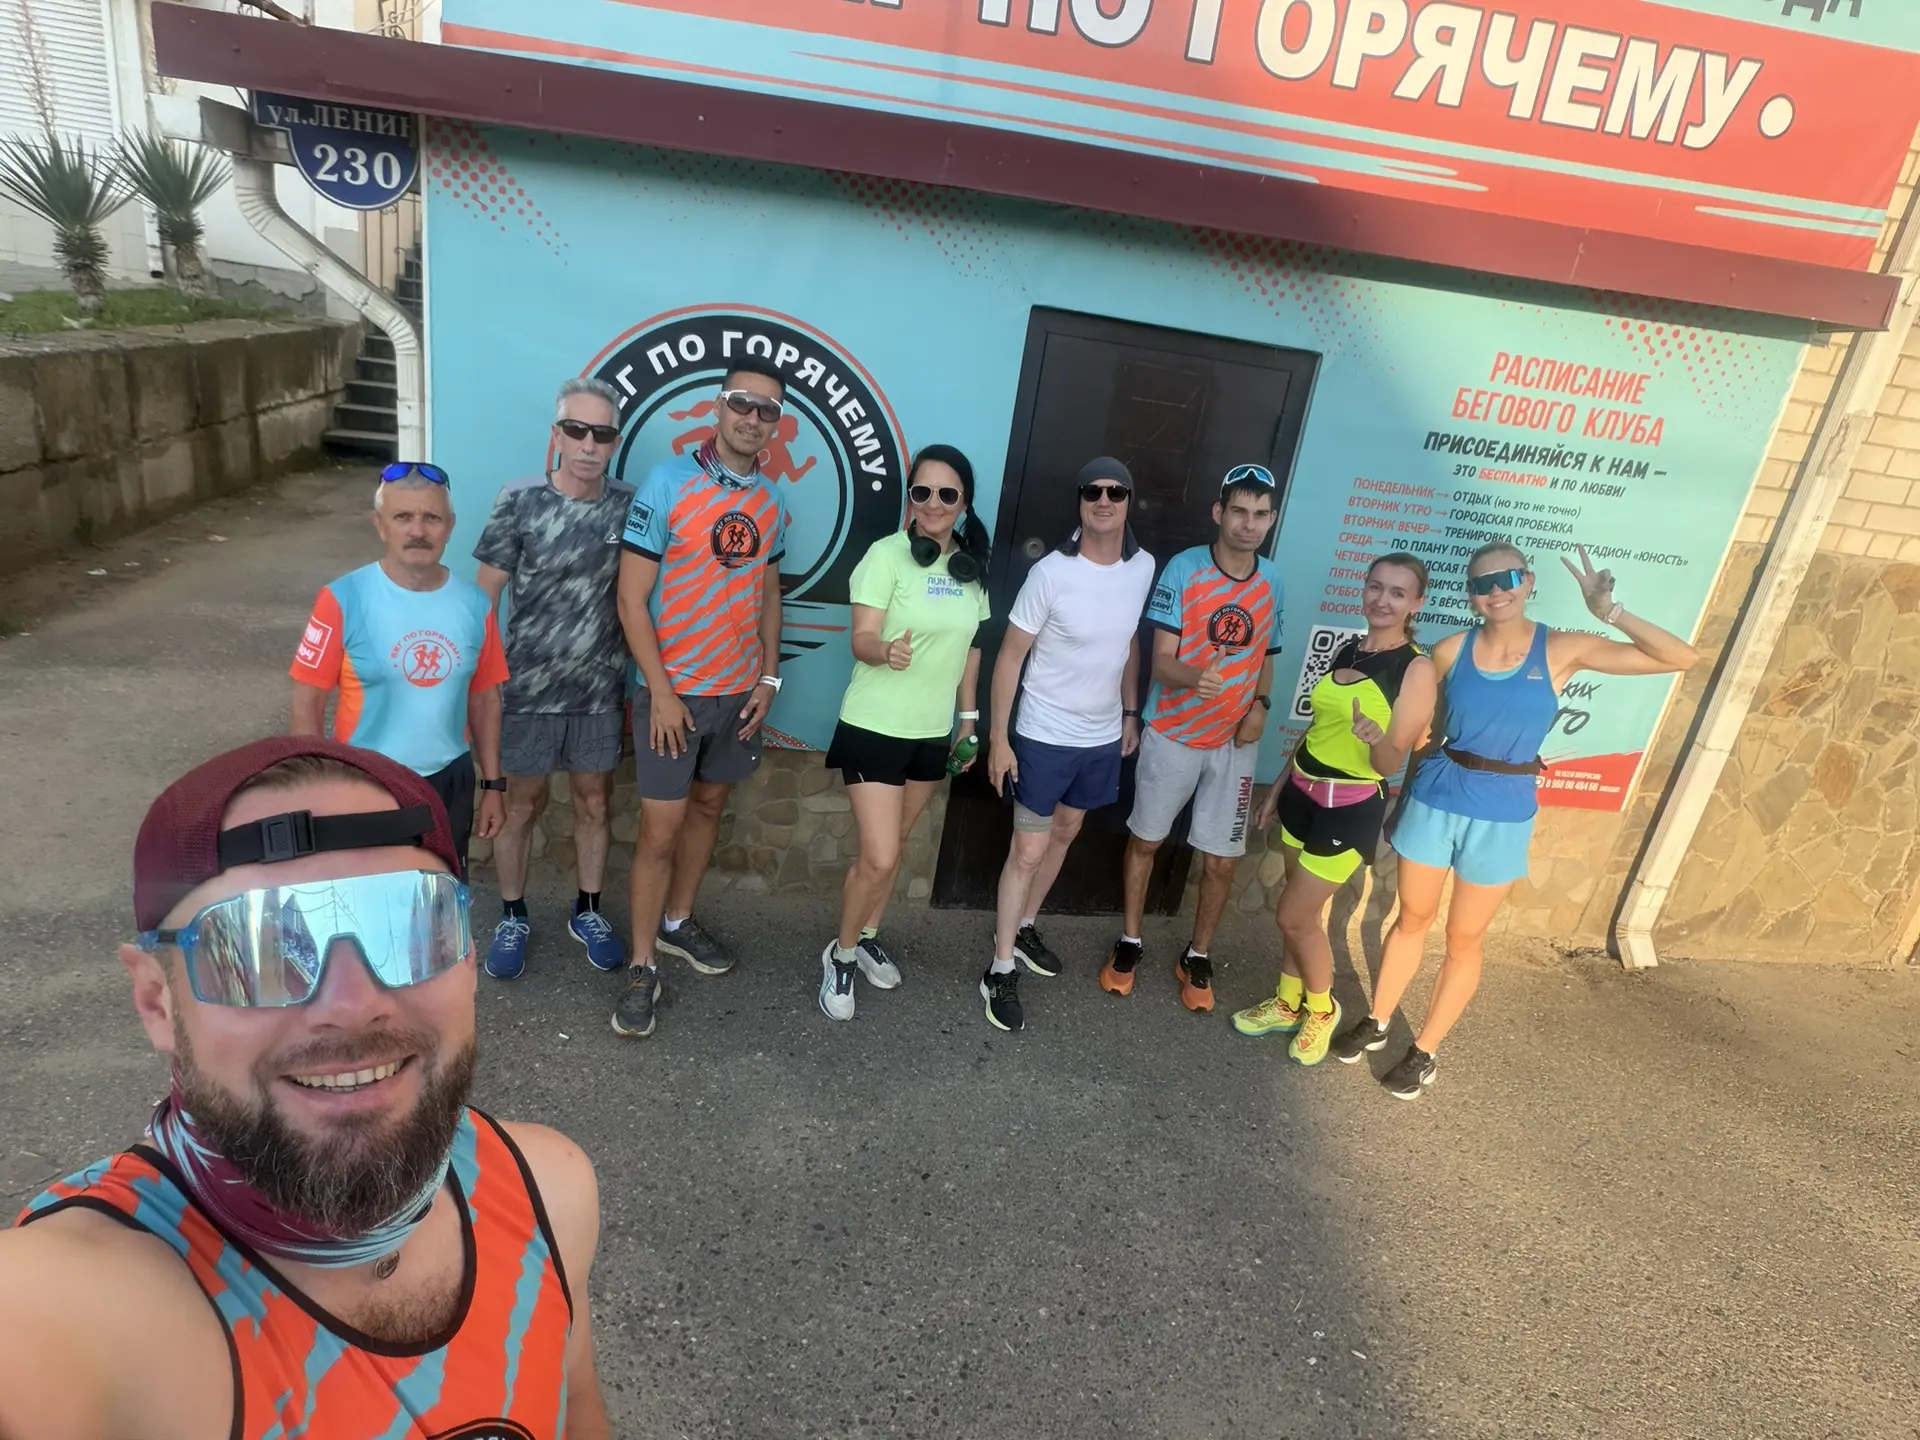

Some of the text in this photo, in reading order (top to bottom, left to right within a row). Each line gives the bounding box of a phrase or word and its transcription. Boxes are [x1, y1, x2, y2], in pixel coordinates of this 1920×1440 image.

[313, 143, 402, 189] 230
[1489, 351, 1652, 405] РАСПИСАНИЕ
[646, 334, 706, 376] ПО
[722, 330, 887, 477] ГОРЯЧЕМУ
[1451, 387, 1665, 447] БЕГОВОГО КЛУБА
[1423, 431, 1650, 480] ПРИСОЕДИНЯЙСЯ К НАМ
[1453, 464, 1477, 478] ЭТО
[1478, 466, 1548, 488] БЕСПЛАТНО
[1550, 477, 1560, 490] И
[1561, 478, 1577, 491] ПО
[1347, 496, 1574, 535] ВТОРНИК УТРО ГОРОДСКАЯ ПРОБЕЖКА
[1352, 477, 1435, 499] ПОНЕДЕЛЬНИК
[1453, 490, 1493, 507] ОТДЫХ
[1512, 501, 1530, 511] это
[1532, 503, 1545, 513] не
[1547, 505, 1582, 519] точно)
[1338, 531, 1373, 547] СРЕДА
[1390, 538, 1408, 550] ПО
[1410, 540, 1449, 557] ПЛАНУ
[1343, 513, 1396, 530] ВТОРНИК
[1397, 520, 1430, 535] ВЕЧЕР
[1444, 526, 1512, 544] ТРЕНИРОВКА
[1515, 535, 1524, 546] С
[1525, 536, 1578, 553] ТРЕНЕРОМ
[927, 576, 946, 586] RUN
[927, 586, 964, 597] DISTANCE
[1328, 567, 1368, 581] ПЯТНИ
[1429, 596, 1437, 606] 5
[1230, 776, 1252, 843] POWERLIFTING
